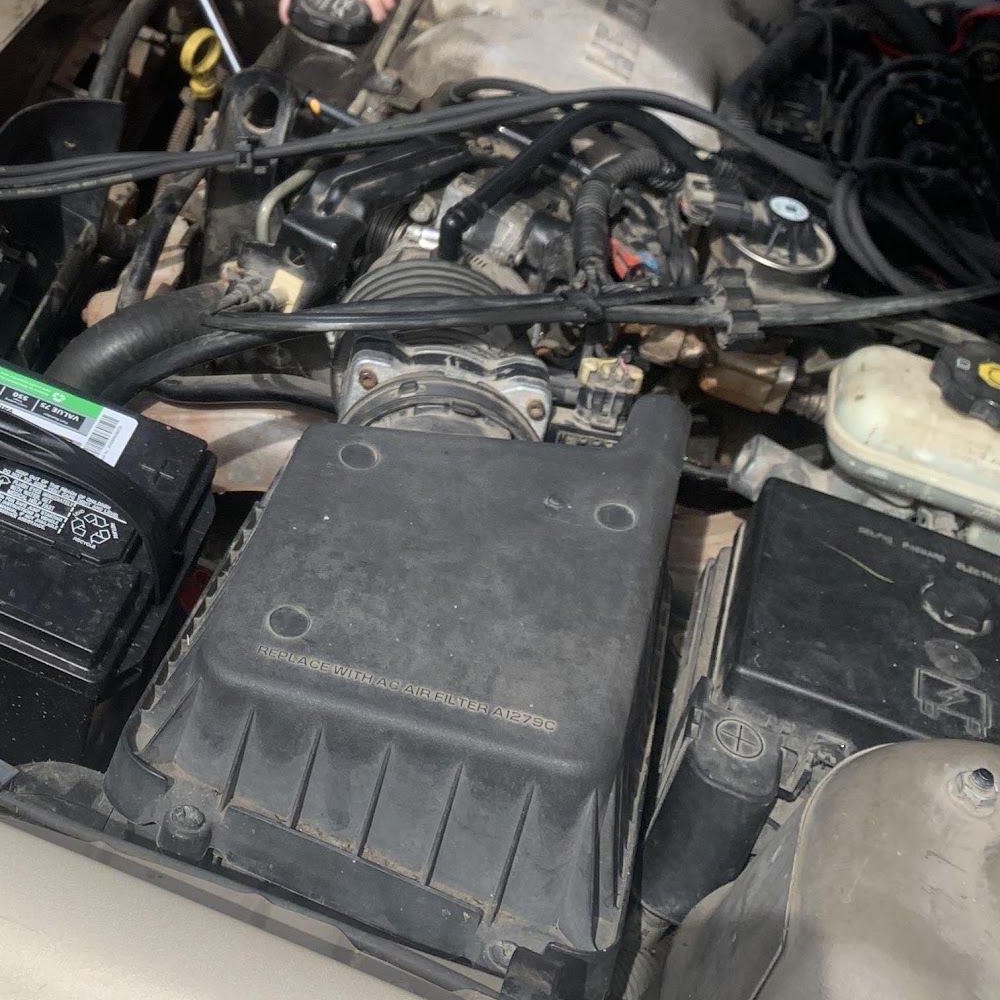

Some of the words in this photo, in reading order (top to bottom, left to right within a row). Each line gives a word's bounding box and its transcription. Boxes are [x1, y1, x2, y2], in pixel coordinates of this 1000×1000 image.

[12, 391, 28, 400] 550
[51, 407, 79, 421] VALUE
[257, 645, 331, 672] REPLACE
[333, 665, 374, 684] WITH
[403, 684, 432, 699] AIR
[433, 692, 489, 713] FILTER
[491, 707, 557, 732] A1279C
